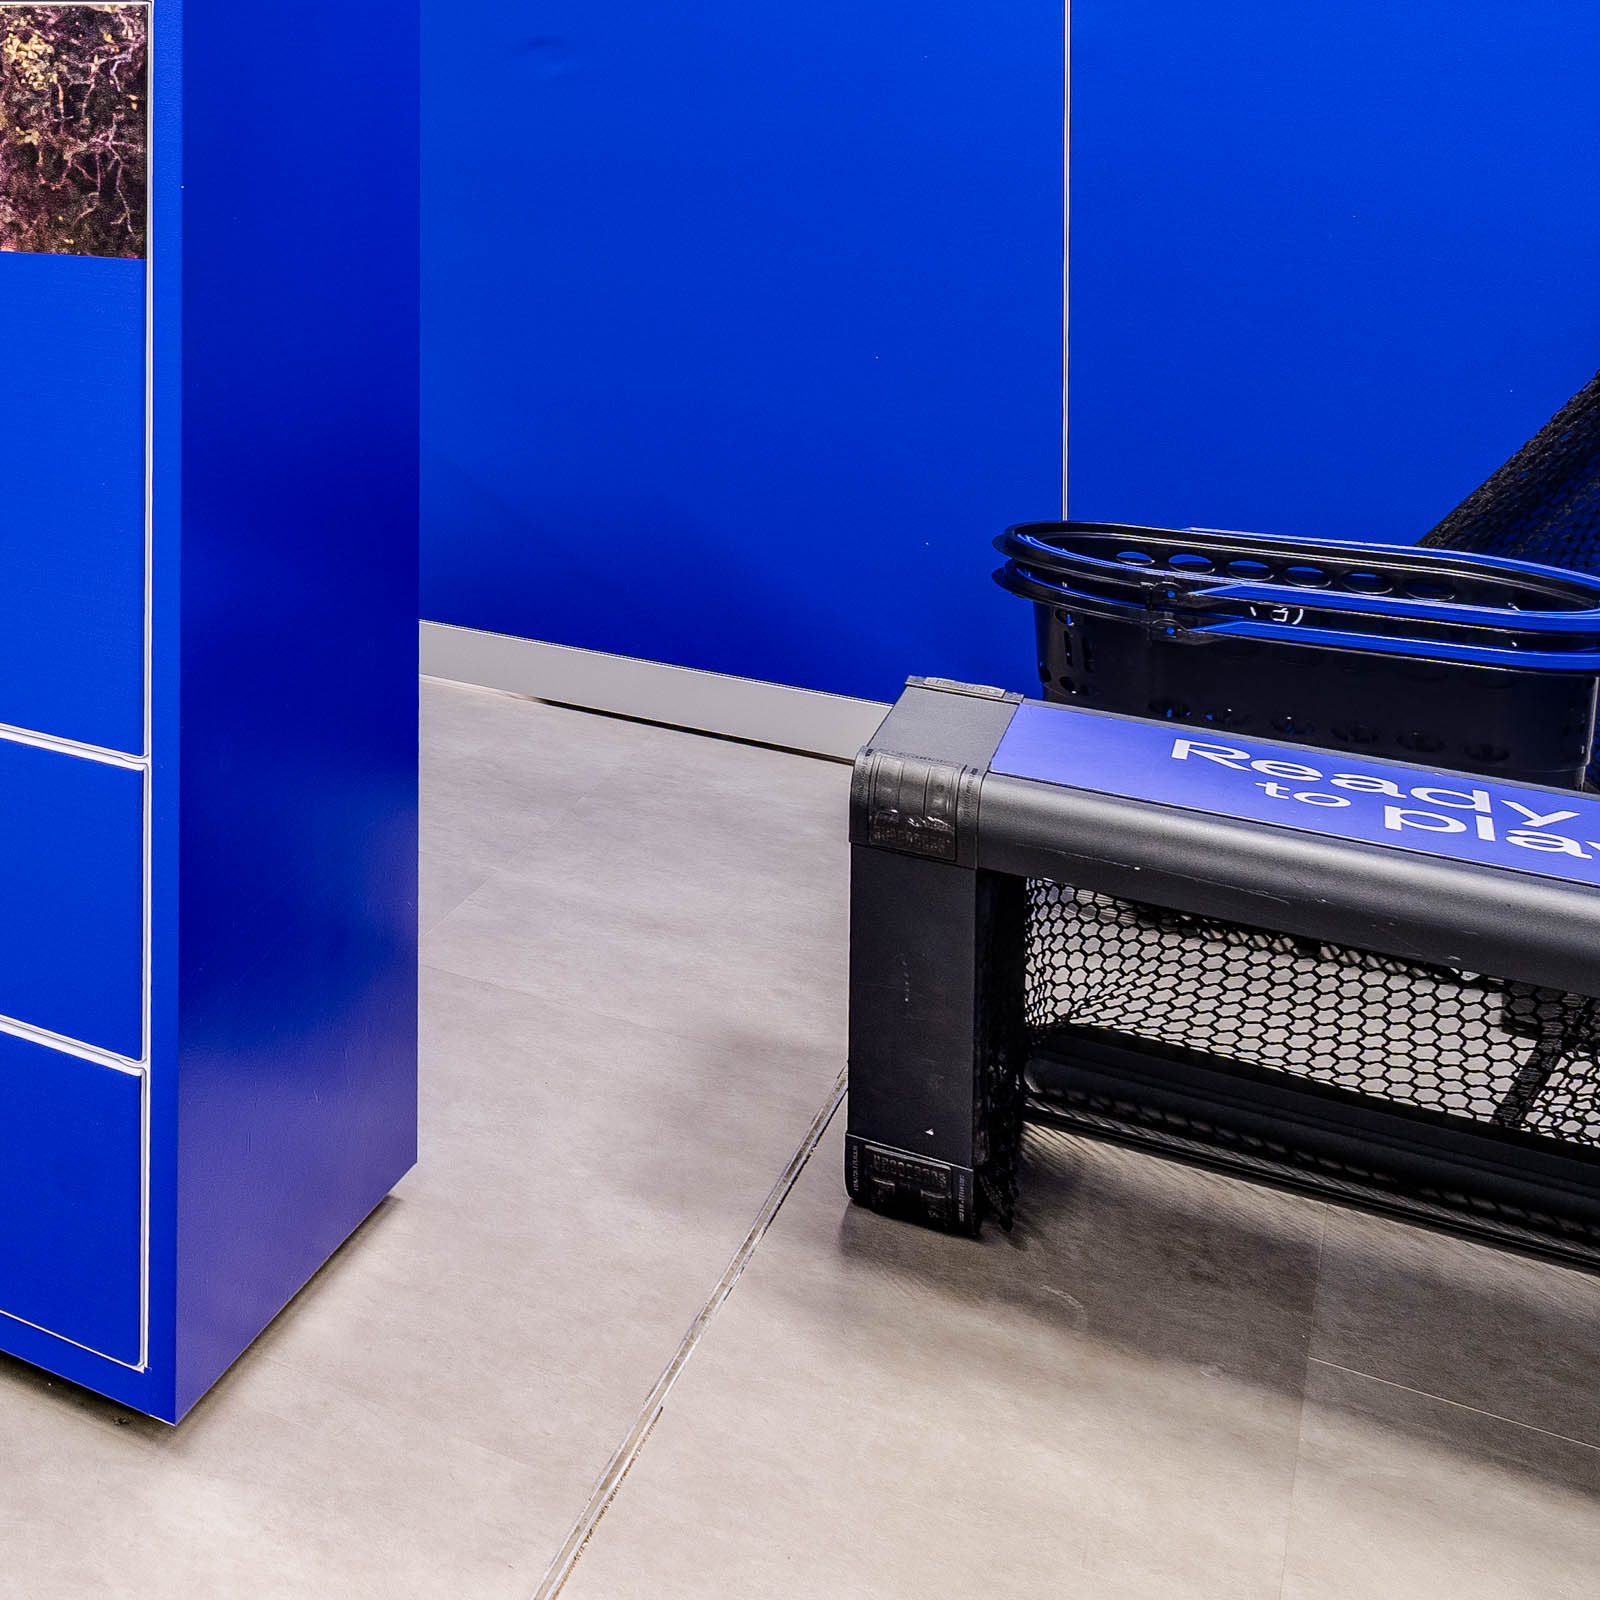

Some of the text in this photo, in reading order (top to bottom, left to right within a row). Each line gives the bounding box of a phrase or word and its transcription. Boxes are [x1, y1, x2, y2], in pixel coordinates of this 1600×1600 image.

[1171, 739, 1580, 828] Ready
[1255, 781, 1600, 859] to pla
